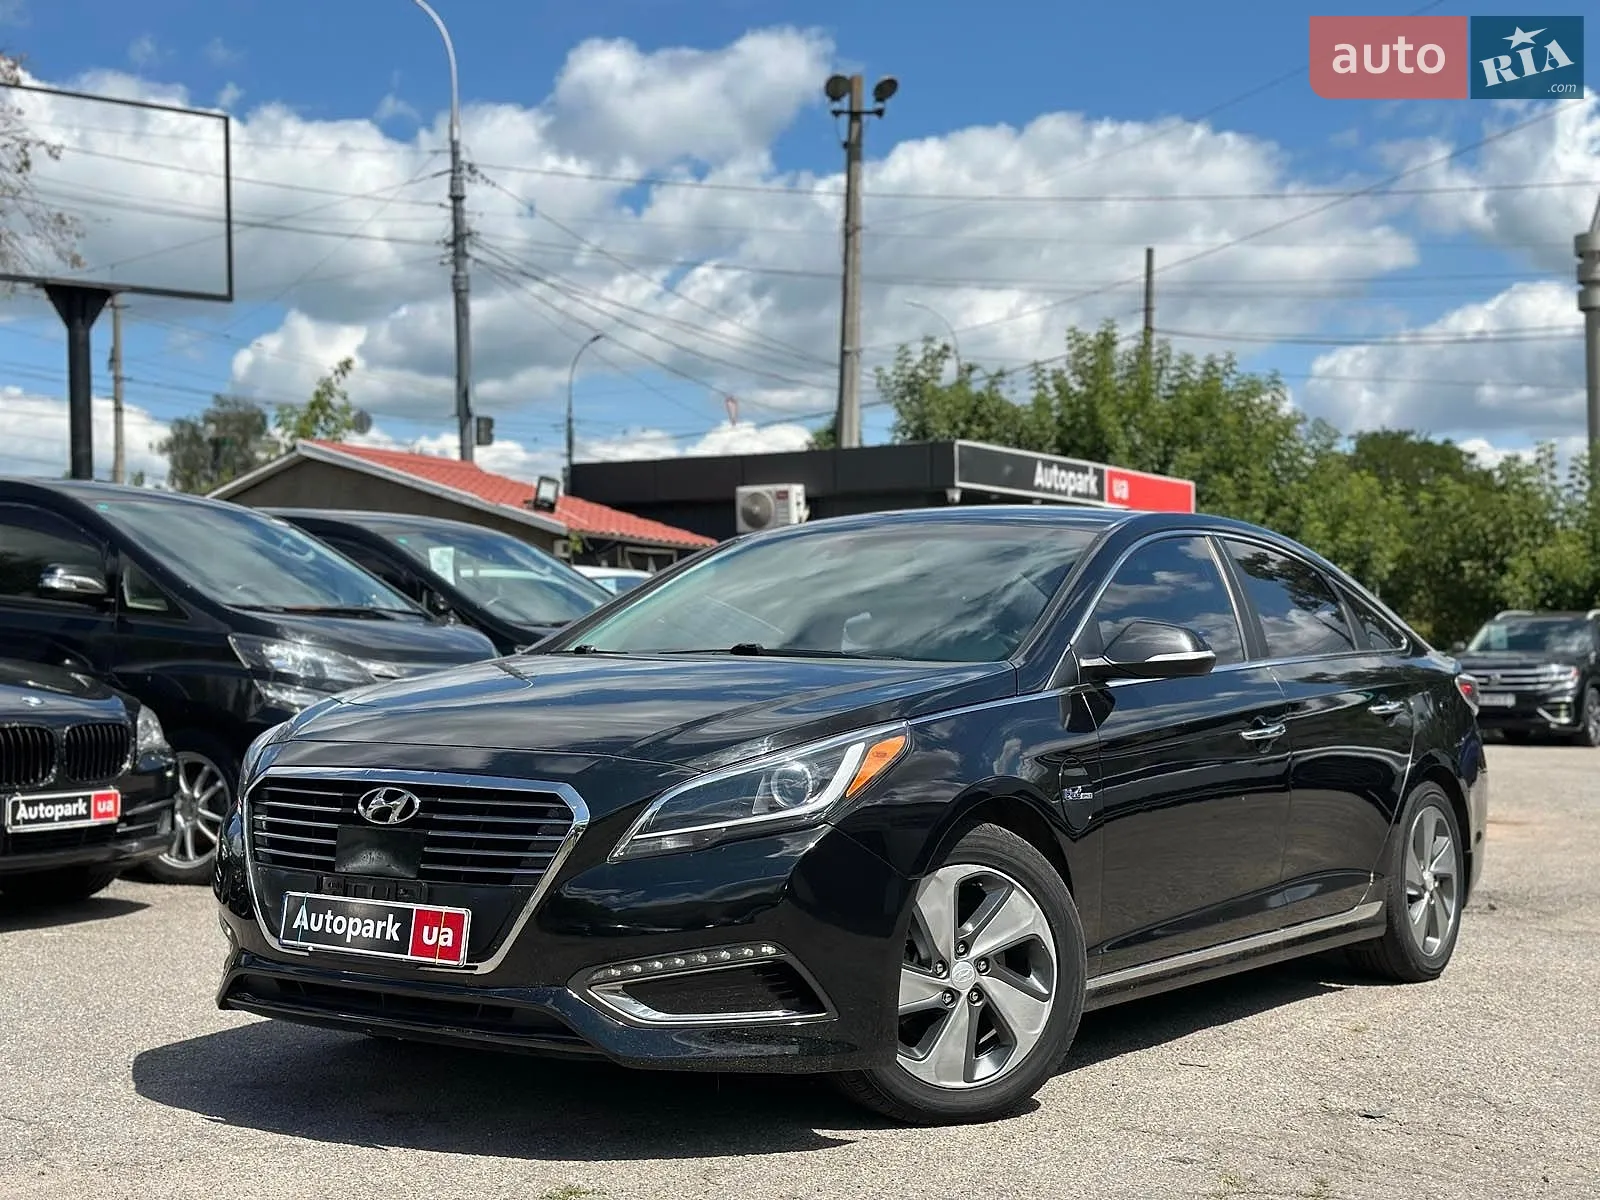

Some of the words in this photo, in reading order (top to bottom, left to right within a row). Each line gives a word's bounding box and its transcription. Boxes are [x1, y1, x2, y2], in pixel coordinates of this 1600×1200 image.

[1033, 460, 1099, 497] Autopark
[1112, 478, 1129, 499] ua
[16, 798, 87, 821] Autopark
[97, 799, 114, 813] ua
[292, 905, 402, 943] Autopark
[422, 925, 453, 947] ua
